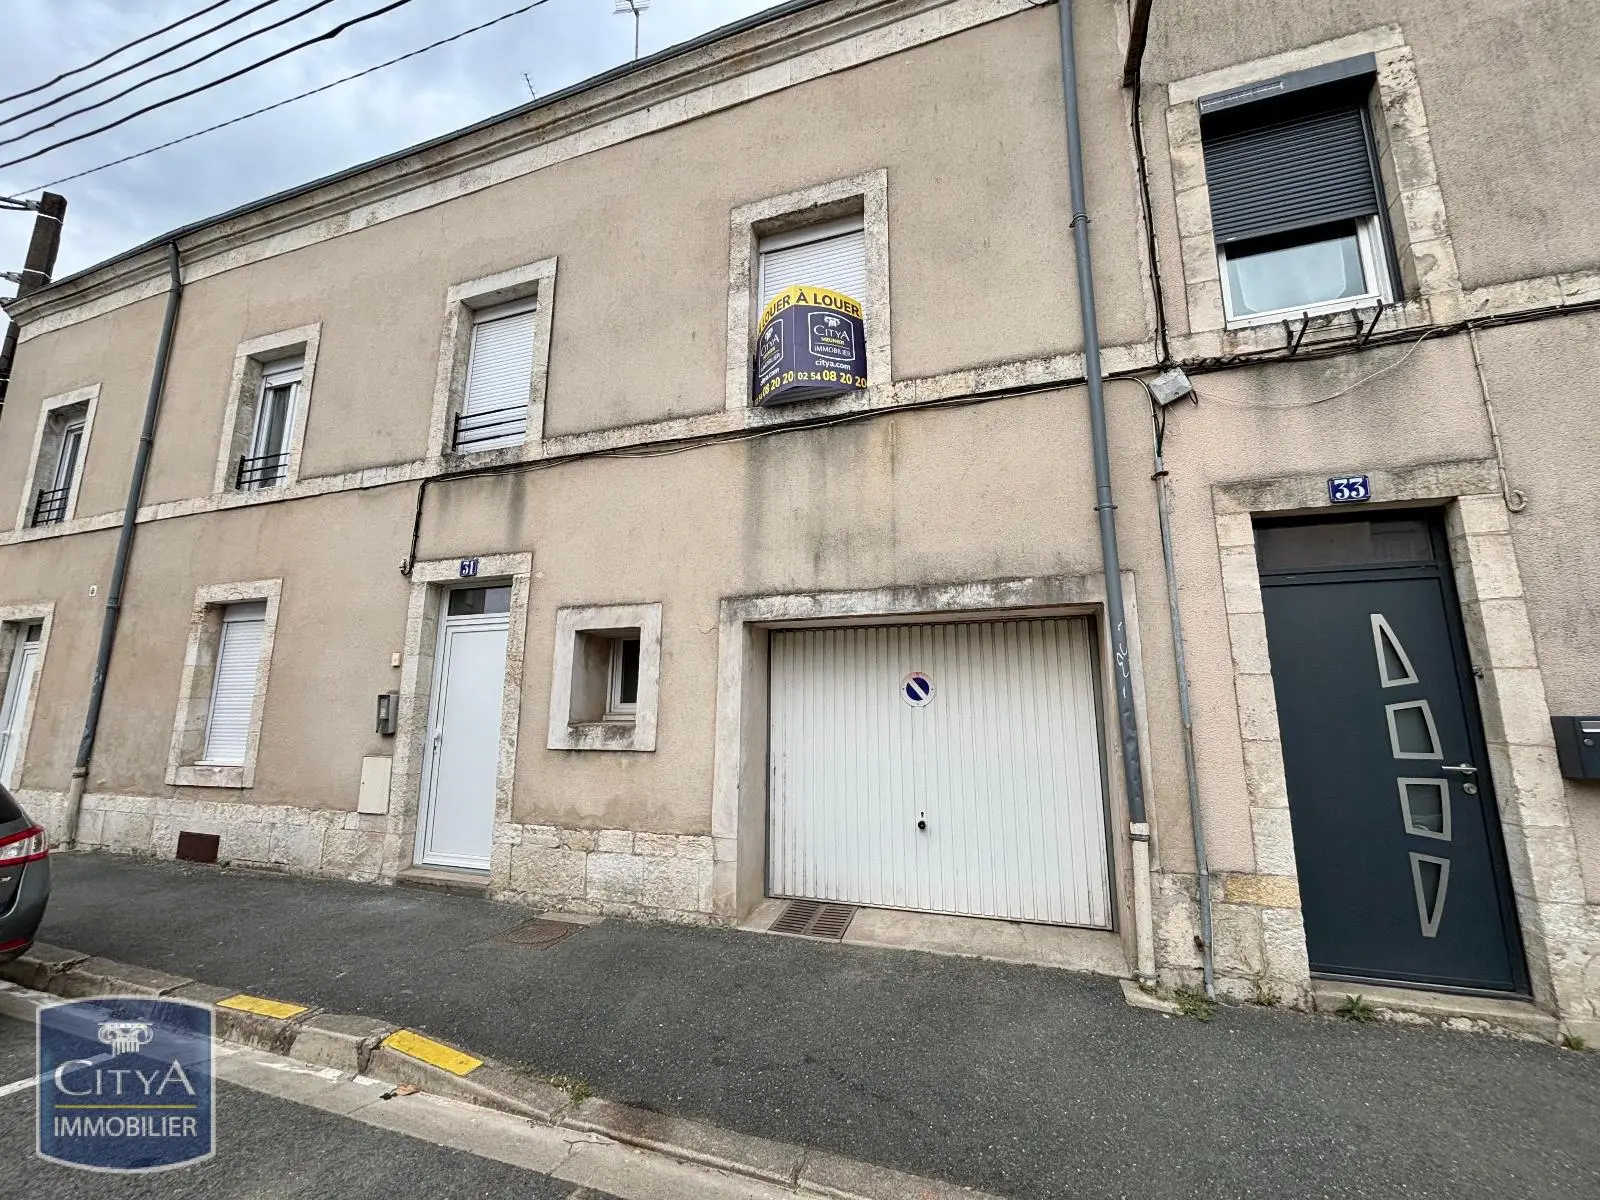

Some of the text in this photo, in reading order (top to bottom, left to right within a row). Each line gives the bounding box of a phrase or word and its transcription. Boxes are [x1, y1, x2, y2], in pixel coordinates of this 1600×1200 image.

[796, 288, 861, 317] À LOUER
[813, 324, 850, 342] CITYA
[814, 345, 851, 357] IMMOBILIER
[815, 358, 851, 370] citya.com
[770, 377, 780, 390] 20
[782, 371, 794, 384] 20
[797, 369, 867, 388] 02 54 08 20 20
[1334, 477, 1366, 500] 33
[462, 560, 474, 575] 31
